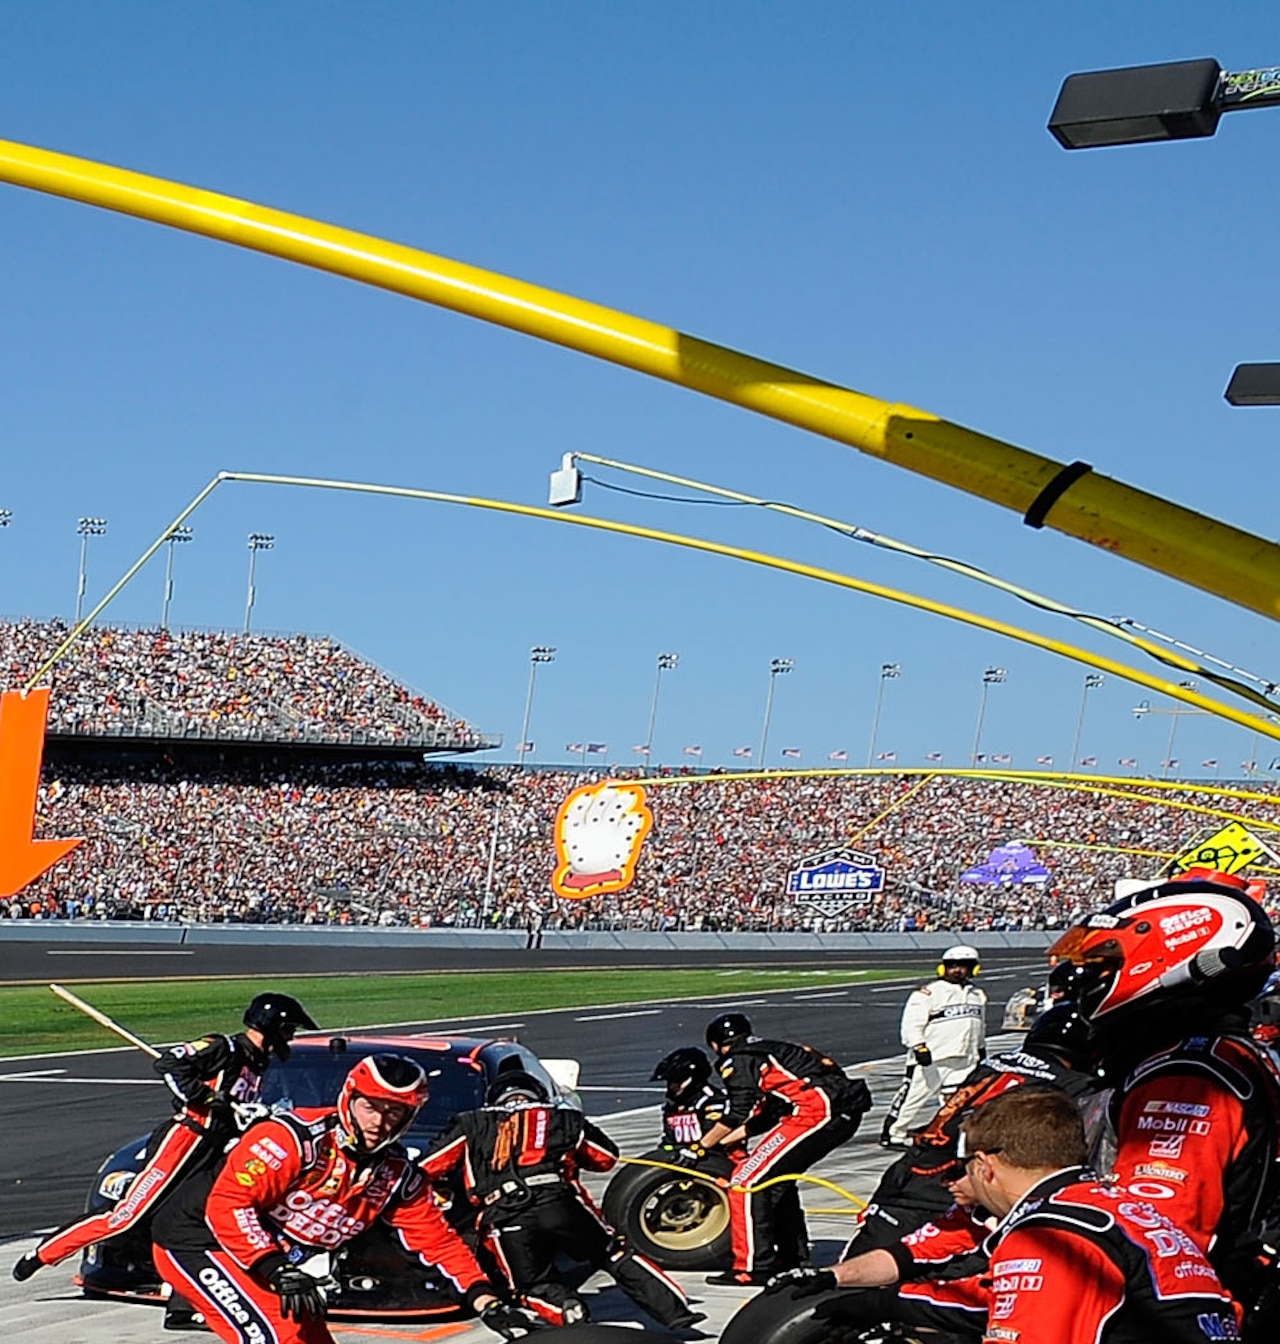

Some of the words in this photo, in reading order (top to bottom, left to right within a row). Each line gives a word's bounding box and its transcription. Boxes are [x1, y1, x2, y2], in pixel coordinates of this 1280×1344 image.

[811, 851, 870, 867] TEAM
[800, 870, 873, 891] LOWE'S
[798, 893, 867, 902] RACING
[1138, 1116, 1187, 1131] Mobil
[286, 1190, 365, 1234] Office
[199, 1266, 250, 1325] Office
